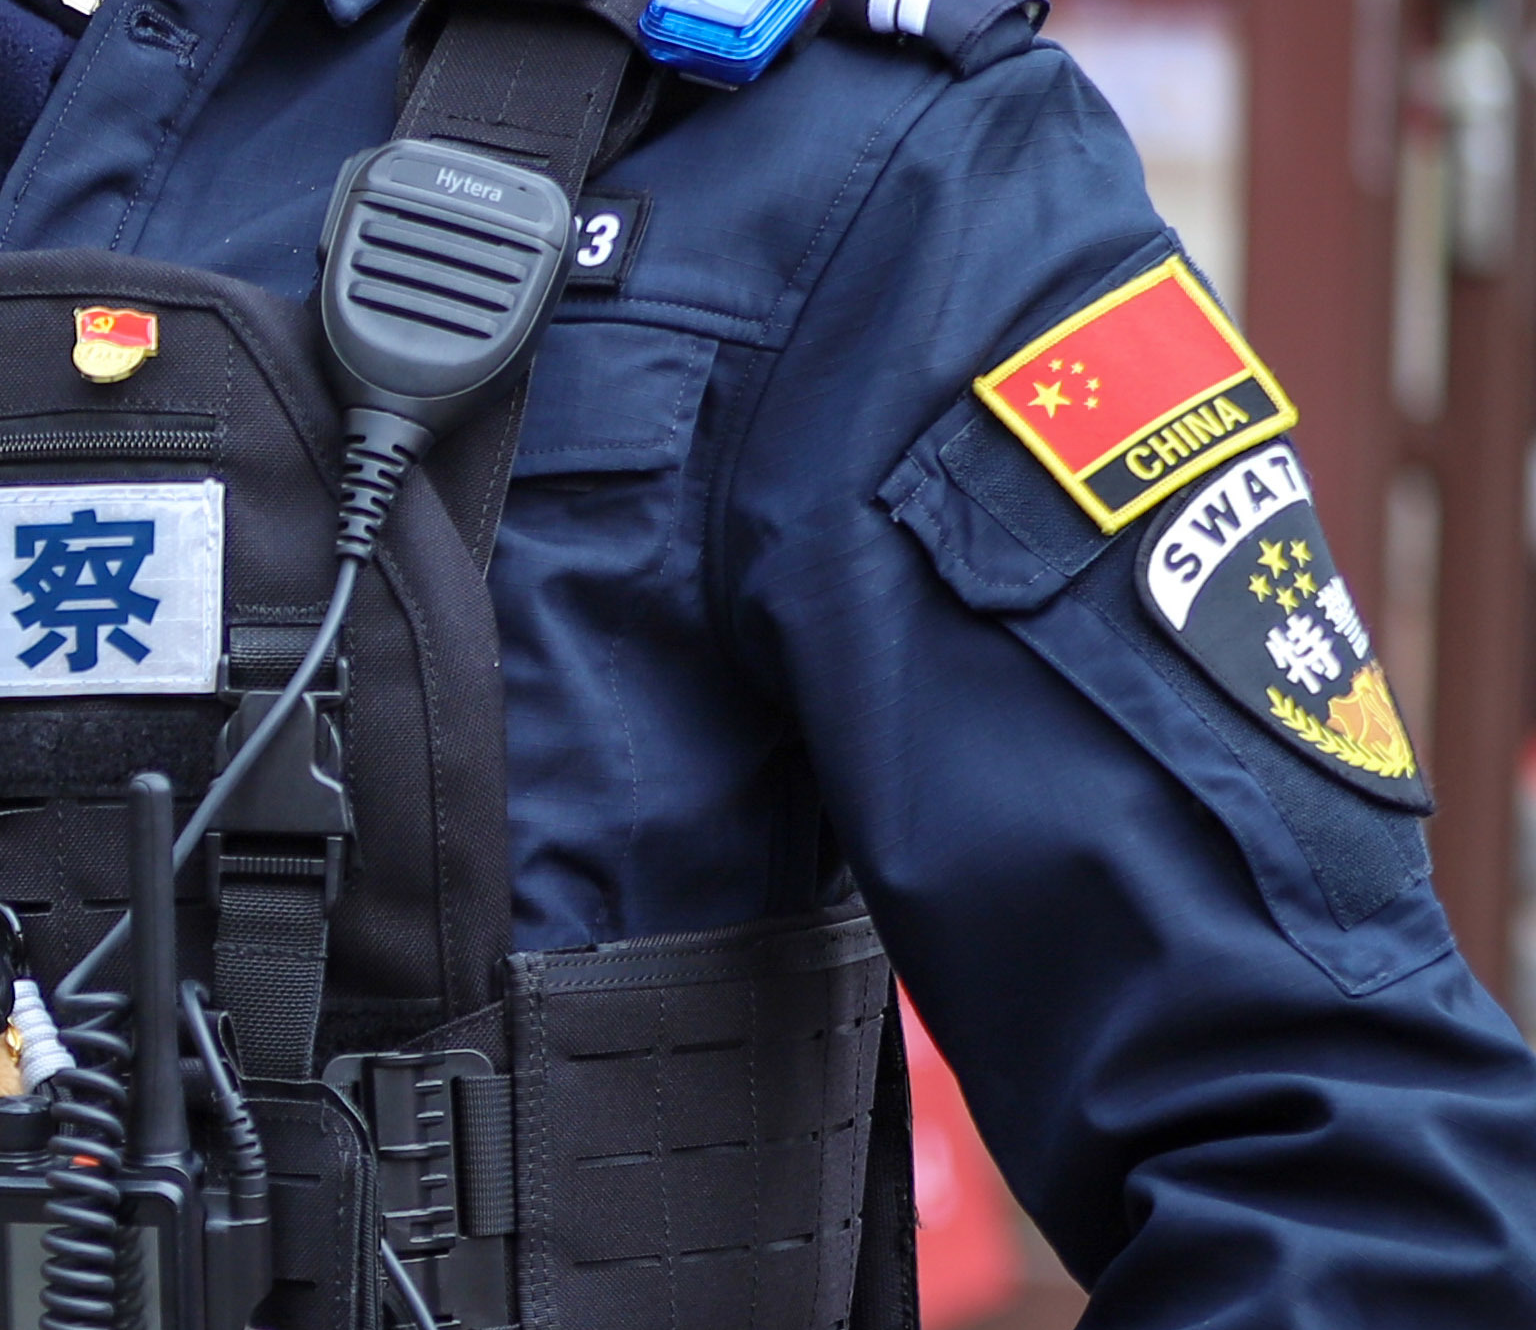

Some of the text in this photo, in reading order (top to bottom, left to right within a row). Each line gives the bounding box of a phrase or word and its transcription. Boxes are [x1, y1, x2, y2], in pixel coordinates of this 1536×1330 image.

[434, 167, 503, 204] Hytera
[573, 212, 622, 268] 3
[1125, 395, 1250, 483] CHINA
[1163, 455, 1307, 585] SWAT
